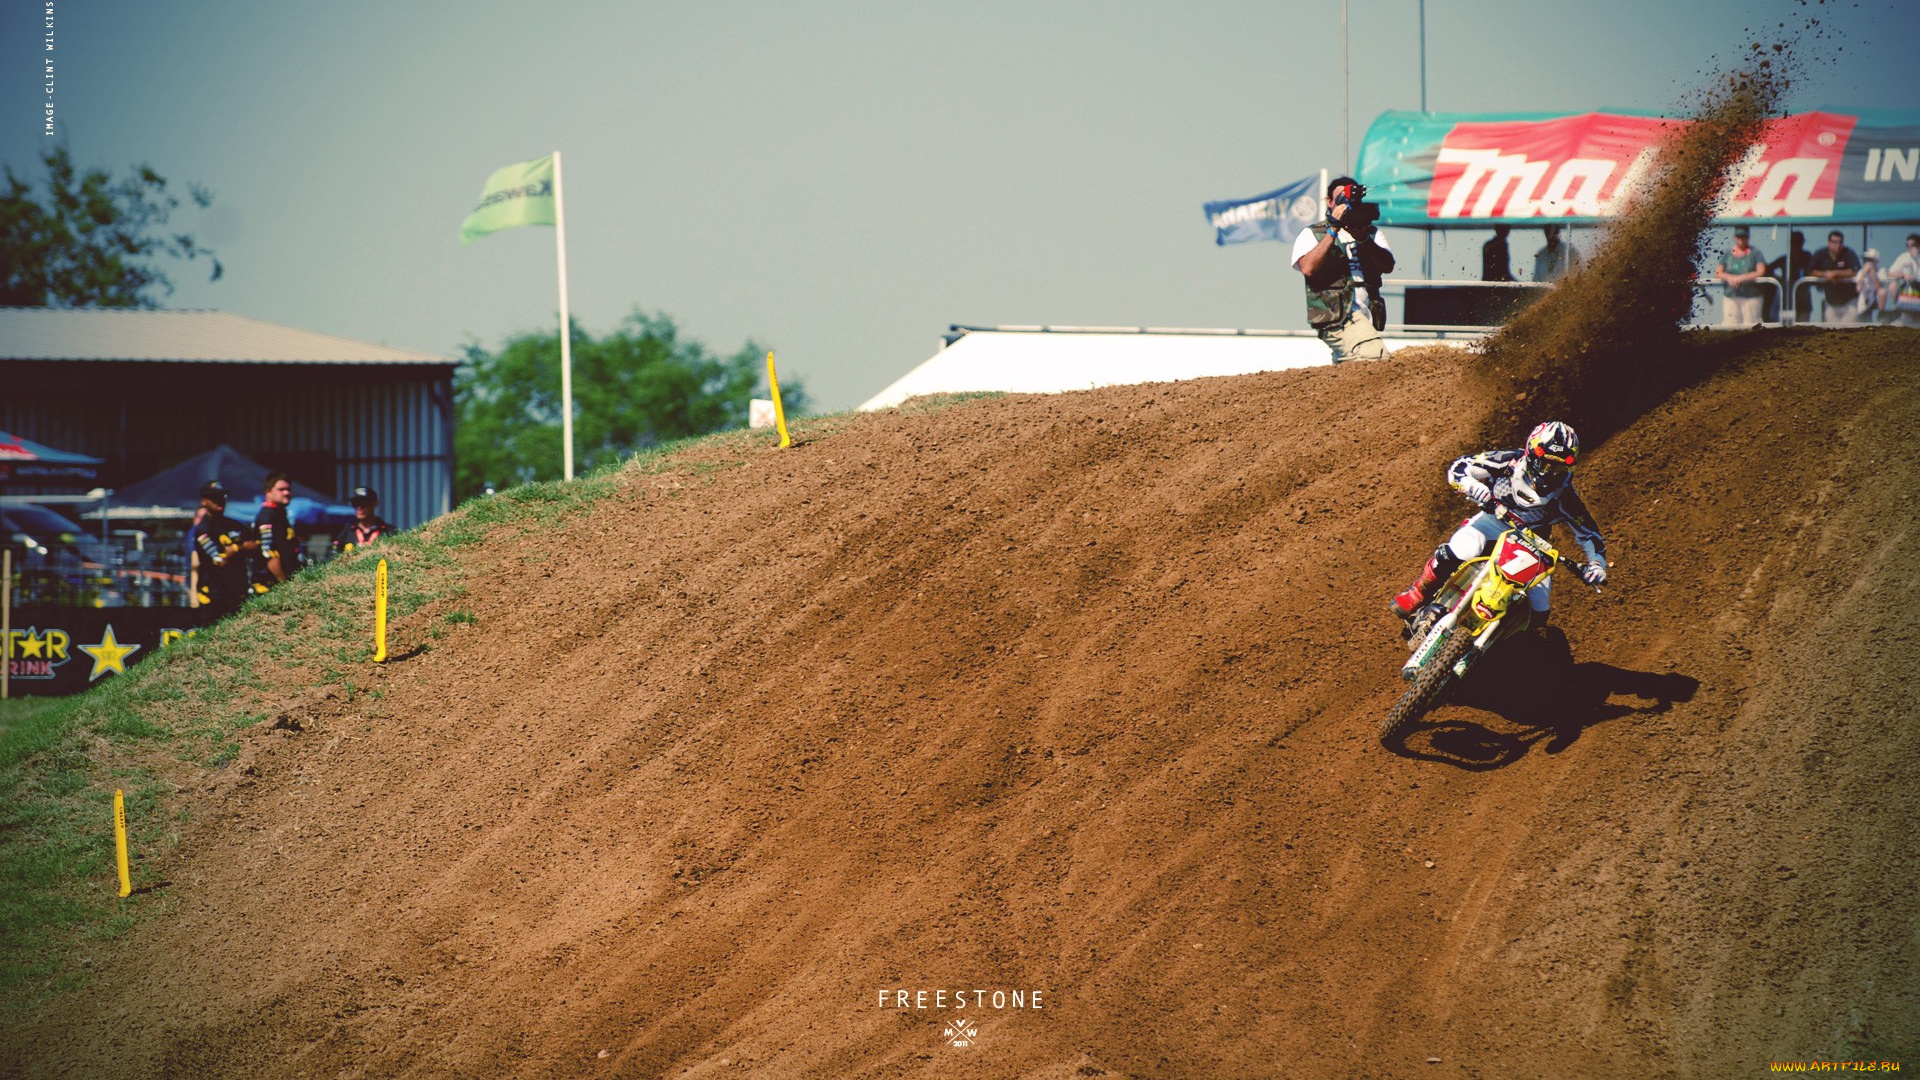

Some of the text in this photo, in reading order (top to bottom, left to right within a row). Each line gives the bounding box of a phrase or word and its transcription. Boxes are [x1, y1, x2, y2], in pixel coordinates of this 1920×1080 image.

[1438, 144, 1920, 217] Mata IN
[1500, 549, 1540, 576] 1
[0, 630, 67, 659] TAR
[0, 660, 52, 676] RINK
